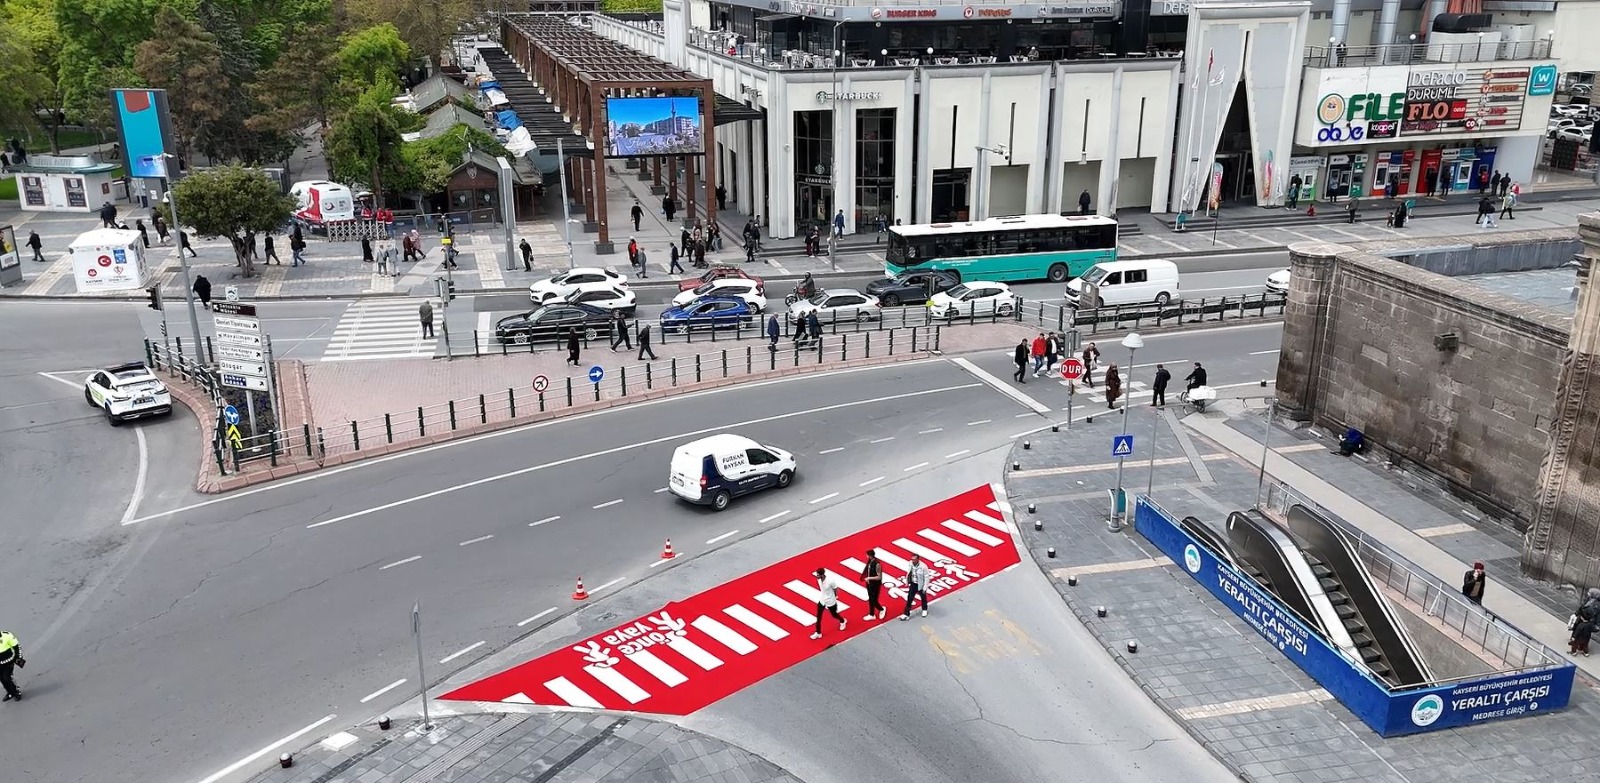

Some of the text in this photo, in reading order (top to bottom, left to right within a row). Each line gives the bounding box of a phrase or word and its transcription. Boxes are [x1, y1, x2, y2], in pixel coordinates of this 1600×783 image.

[886, 9, 937, 18] BURGER KING
[1162, 2, 1190, 14] DeFa
[1410, 70, 1466, 86] DeFacto
[1407, 101, 1449, 120] FLO
[1062, 365, 1081, 374] DUR
[1218, 574, 1307, 656] YERALTI ÇARŞISI
[602, 621, 653, 645] yaya
[617, 631, 672, 655] önce
[1452, 674, 1553, 696] KAYSERİ BÜYÜKŞEHİR BELEDİYESİ
[1451, 685, 1551, 711] YERALTI ÇARŞISI
[1472, 709, 1505, 721] MEDRESE
[1506, 705, 1526, 716] GİRİŞİ
